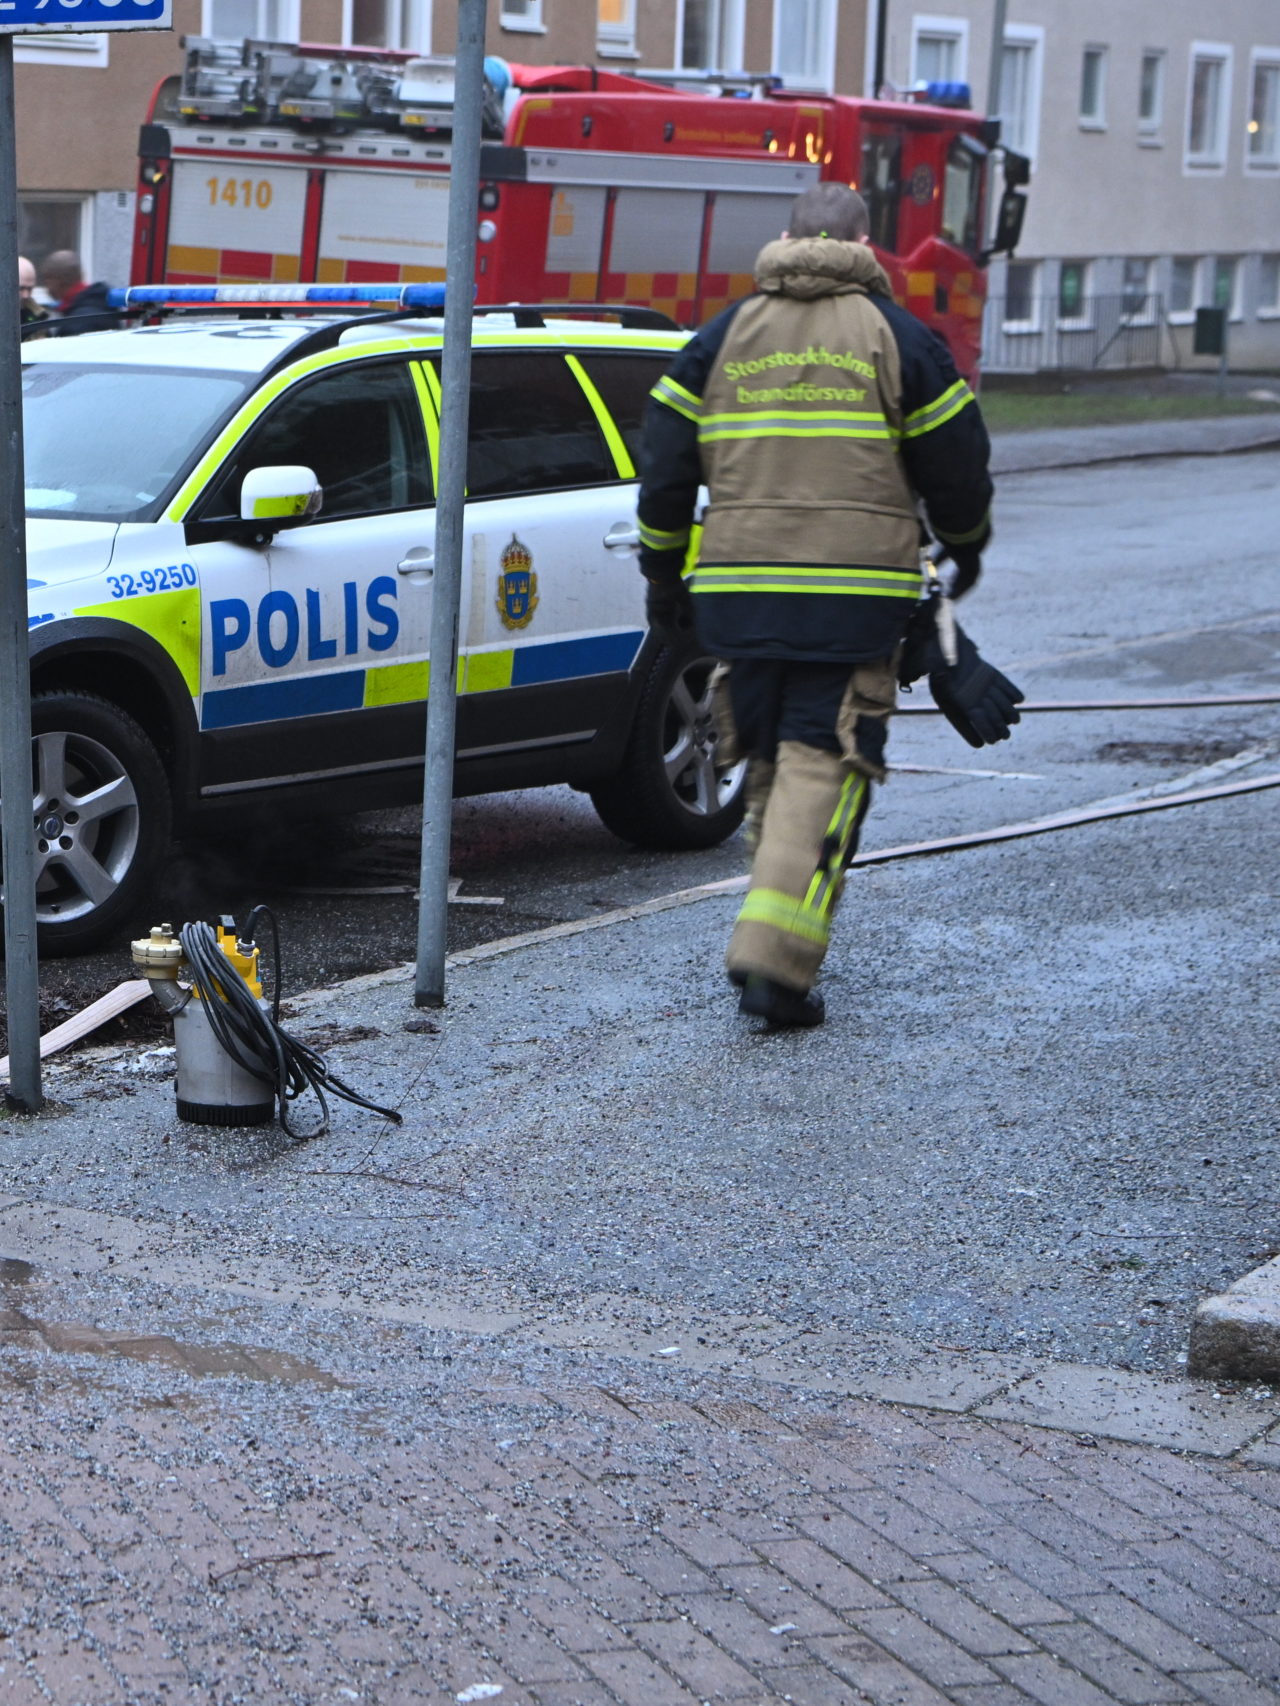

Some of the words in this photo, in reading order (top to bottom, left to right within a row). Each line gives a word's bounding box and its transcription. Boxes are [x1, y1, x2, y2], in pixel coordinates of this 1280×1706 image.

[207, 177, 273, 209] 1410
[723, 347, 877, 381] Storstockholms
[736, 383, 867, 403] brandförsvar
[106, 563, 197, 599] 32-9250
[210, 576, 399, 676] POLIS
